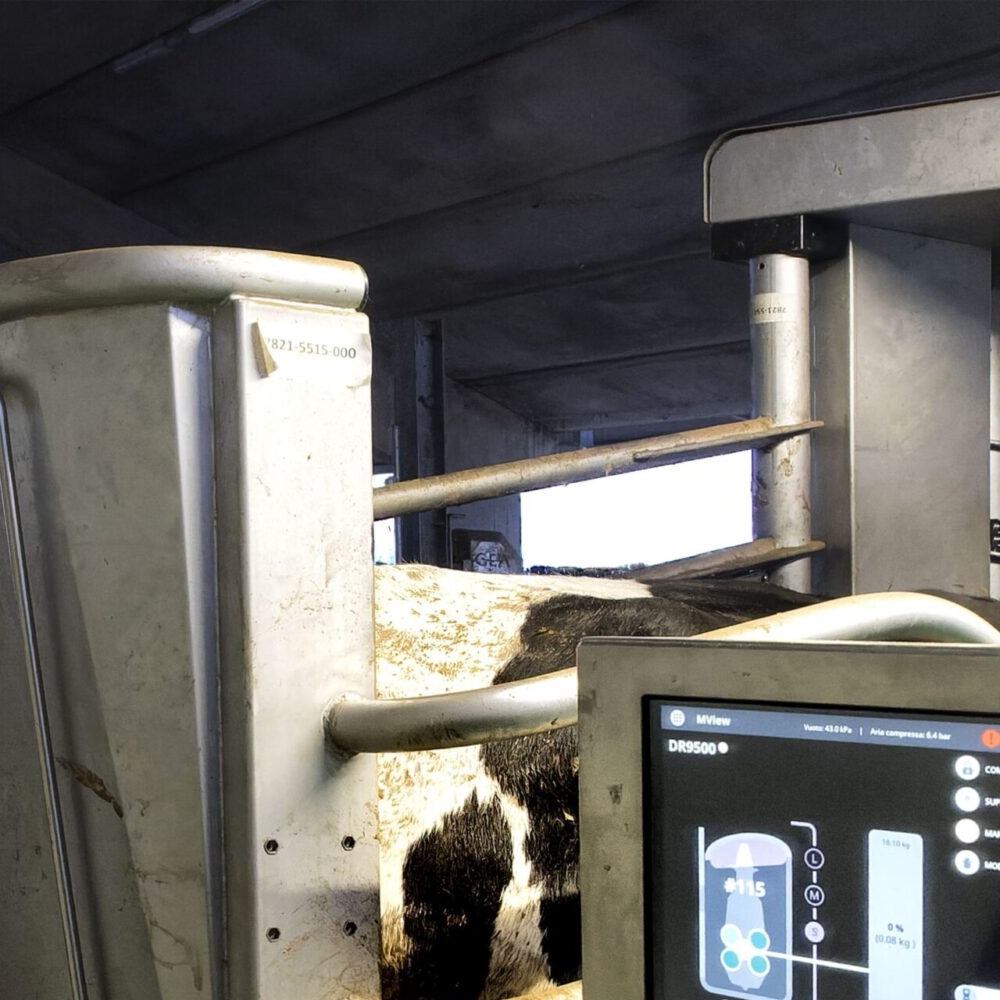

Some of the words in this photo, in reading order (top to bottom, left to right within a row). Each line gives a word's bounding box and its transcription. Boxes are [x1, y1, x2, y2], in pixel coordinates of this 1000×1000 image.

[696, 714, 731, 726] MView
[839, 725, 852, 733] kPa
[870, 727, 884, 736] Aria
[926, 731, 937, 739] 6.4
[938, 731, 951, 740] bar
[668, 739, 716, 755] DR9500
[811, 853, 818, 864] L
[724, 877, 766, 897] #115
[809, 890, 820, 901] M
[811, 927, 819, 937] S
[887, 923, 894, 931] 0
[895, 923, 904, 933] %
